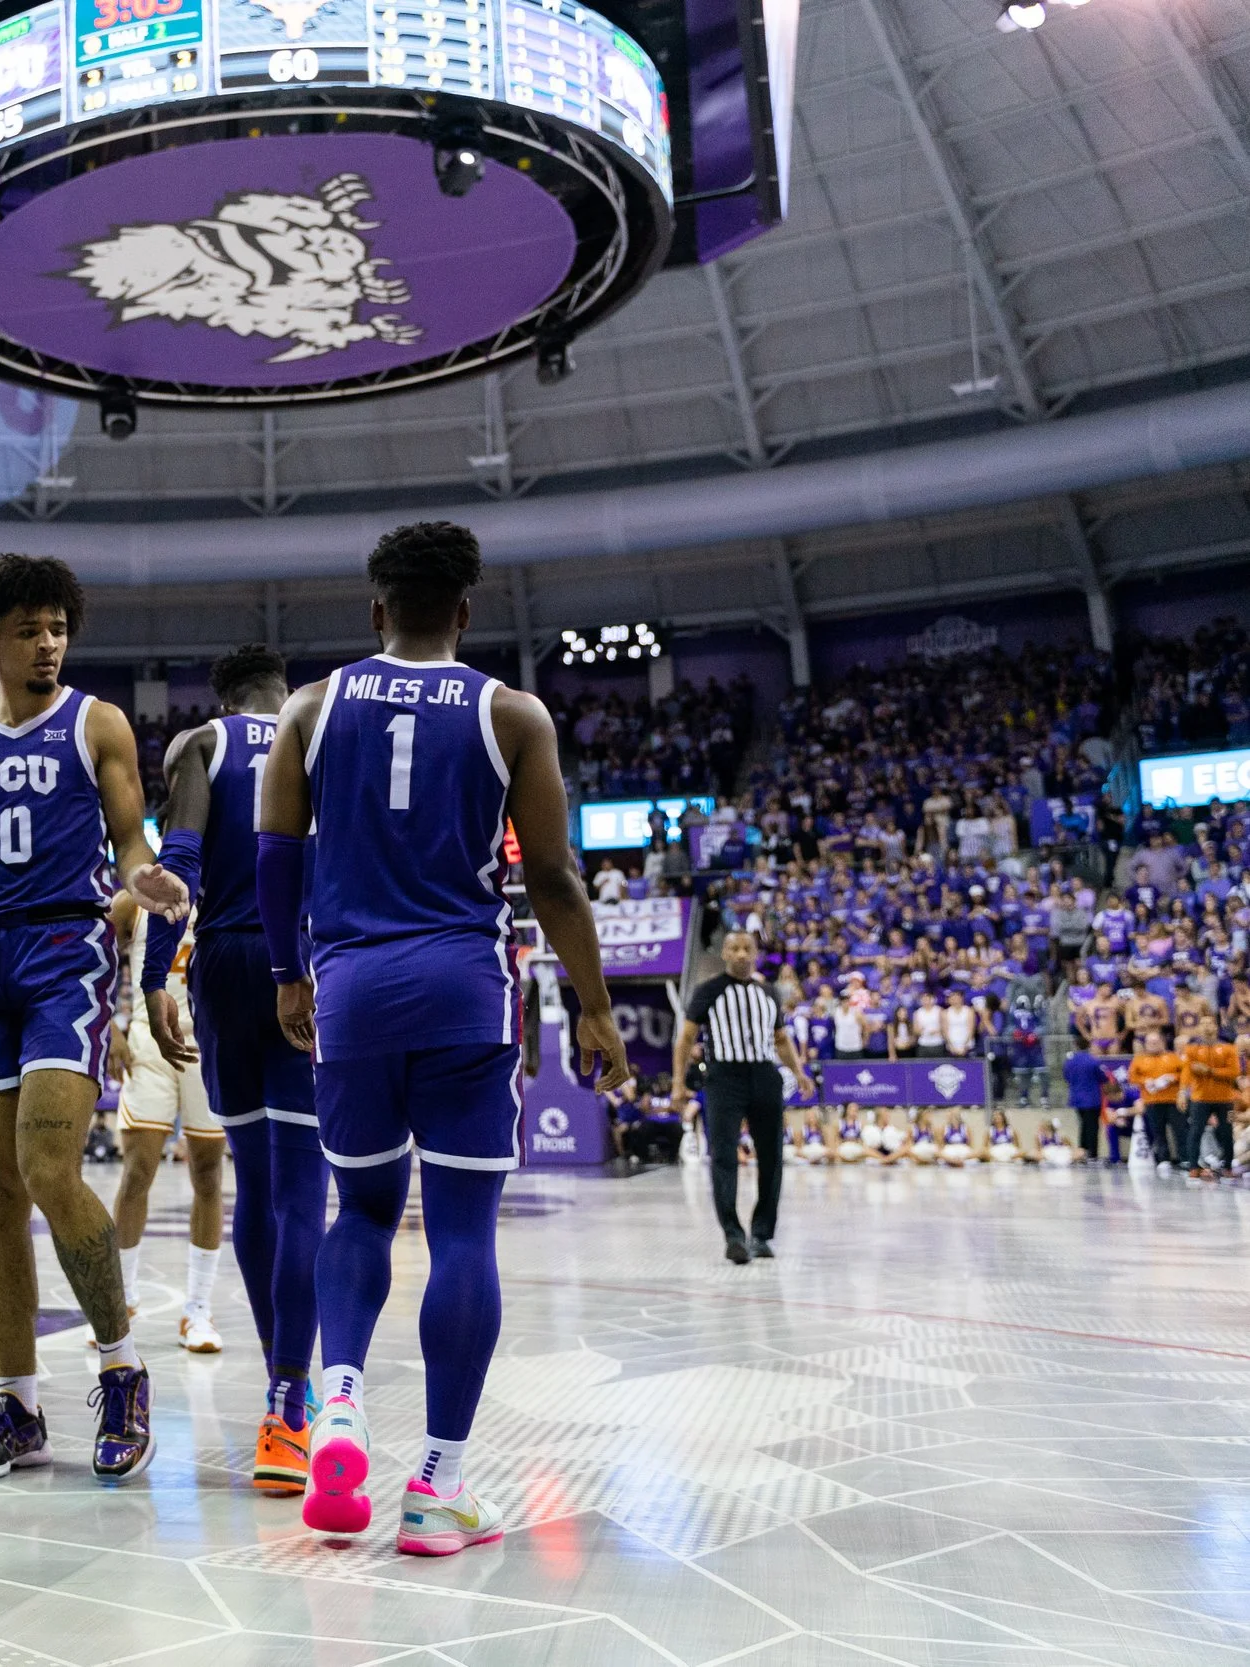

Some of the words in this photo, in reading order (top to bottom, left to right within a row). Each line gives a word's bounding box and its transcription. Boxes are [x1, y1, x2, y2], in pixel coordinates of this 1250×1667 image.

[108, 26, 149, 49] HALF
[155, 22, 166, 40] 2
[177, 51, 191, 69] 2
[268, 49, 319, 82] 60
[173, 73, 197, 92] 10
[344, 674, 423, 704] MILES
[427, 679, 469, 706] JR.
[385, 714, 416, 809] 1
[0, 805, 32, 865] 0
